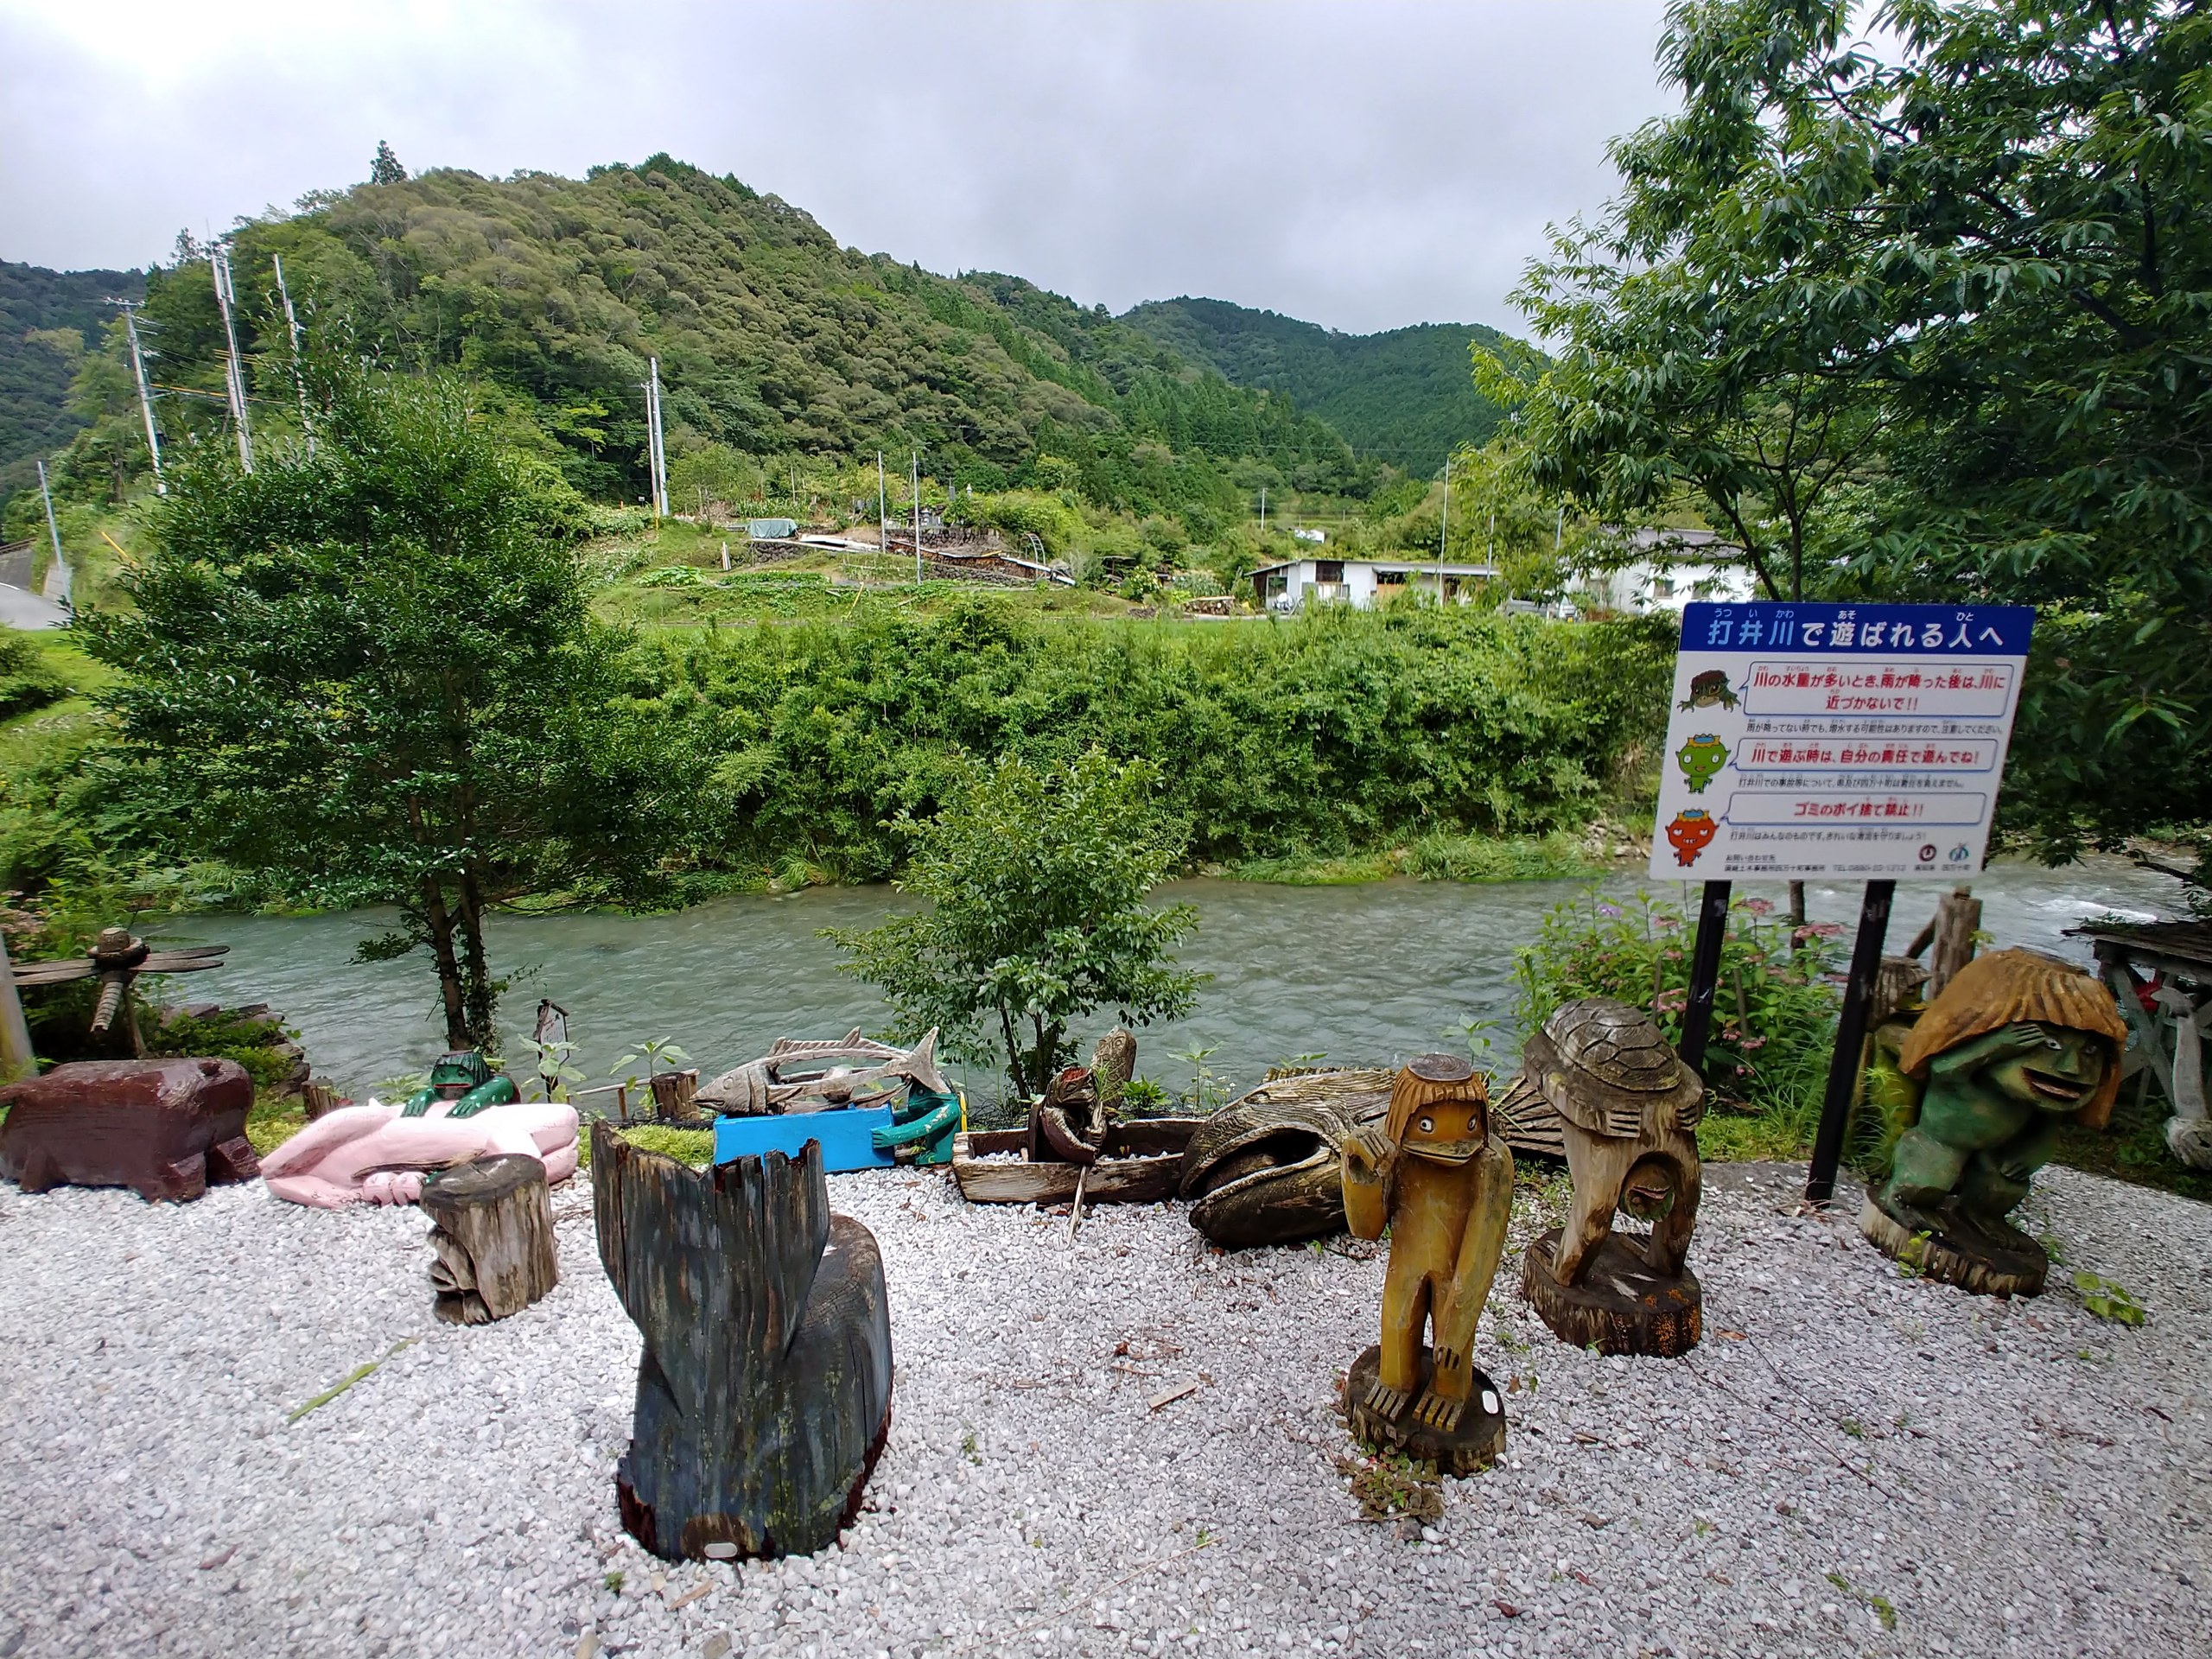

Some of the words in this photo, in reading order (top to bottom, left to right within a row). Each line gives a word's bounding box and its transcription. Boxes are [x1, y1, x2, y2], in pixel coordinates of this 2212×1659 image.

[1714, 608, 1732, 618] うつ
[1776, 609, 1794, 619] かわ
[1838, 610, 1857, 620] あそ
[1956, 612, 1974, 621] ひと
[1707, 620, 2003, 648] 打井川で遊ばれる人へ
[1753, 672, 2005, 689] 川の水量が多いとき、雨が降った後は、川に
[1826, 695, 1918, 710] 近づかないで!!
